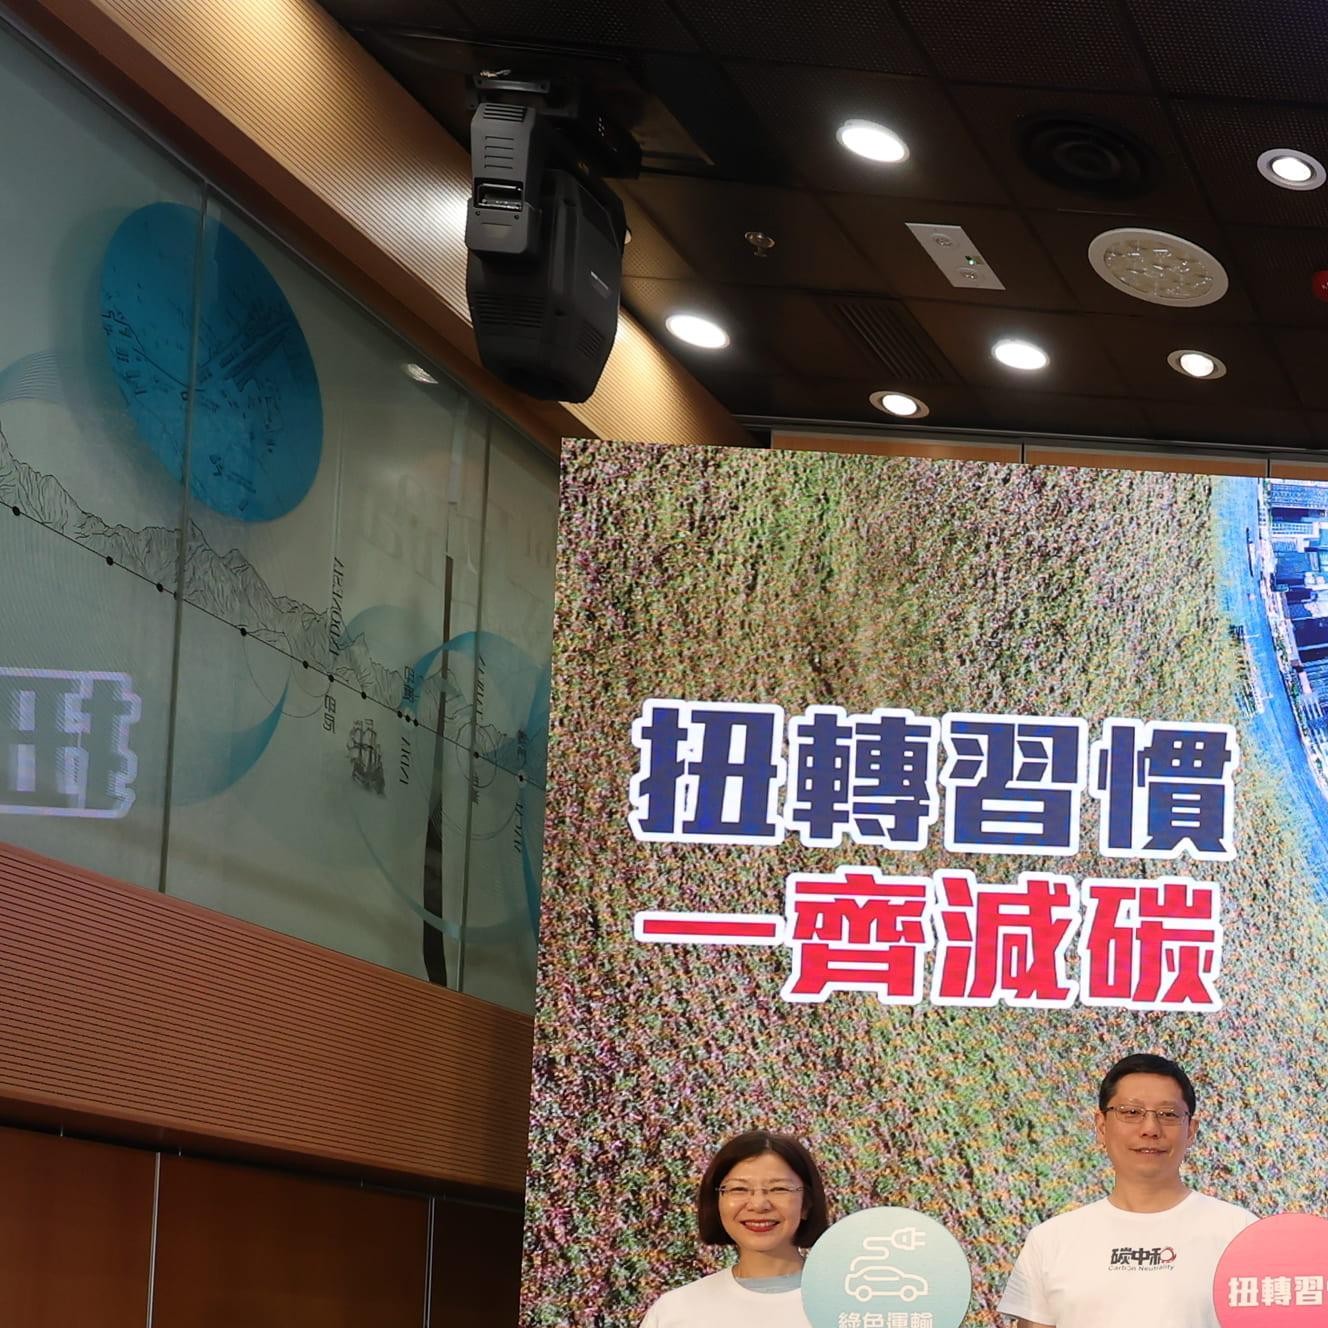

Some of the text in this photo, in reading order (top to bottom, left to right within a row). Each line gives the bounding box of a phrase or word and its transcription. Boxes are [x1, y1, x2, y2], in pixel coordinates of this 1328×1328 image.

[638, 707, 1232, 853] 扭轉習慣
[643, 873, 1215, 1005] 一齊減碳
